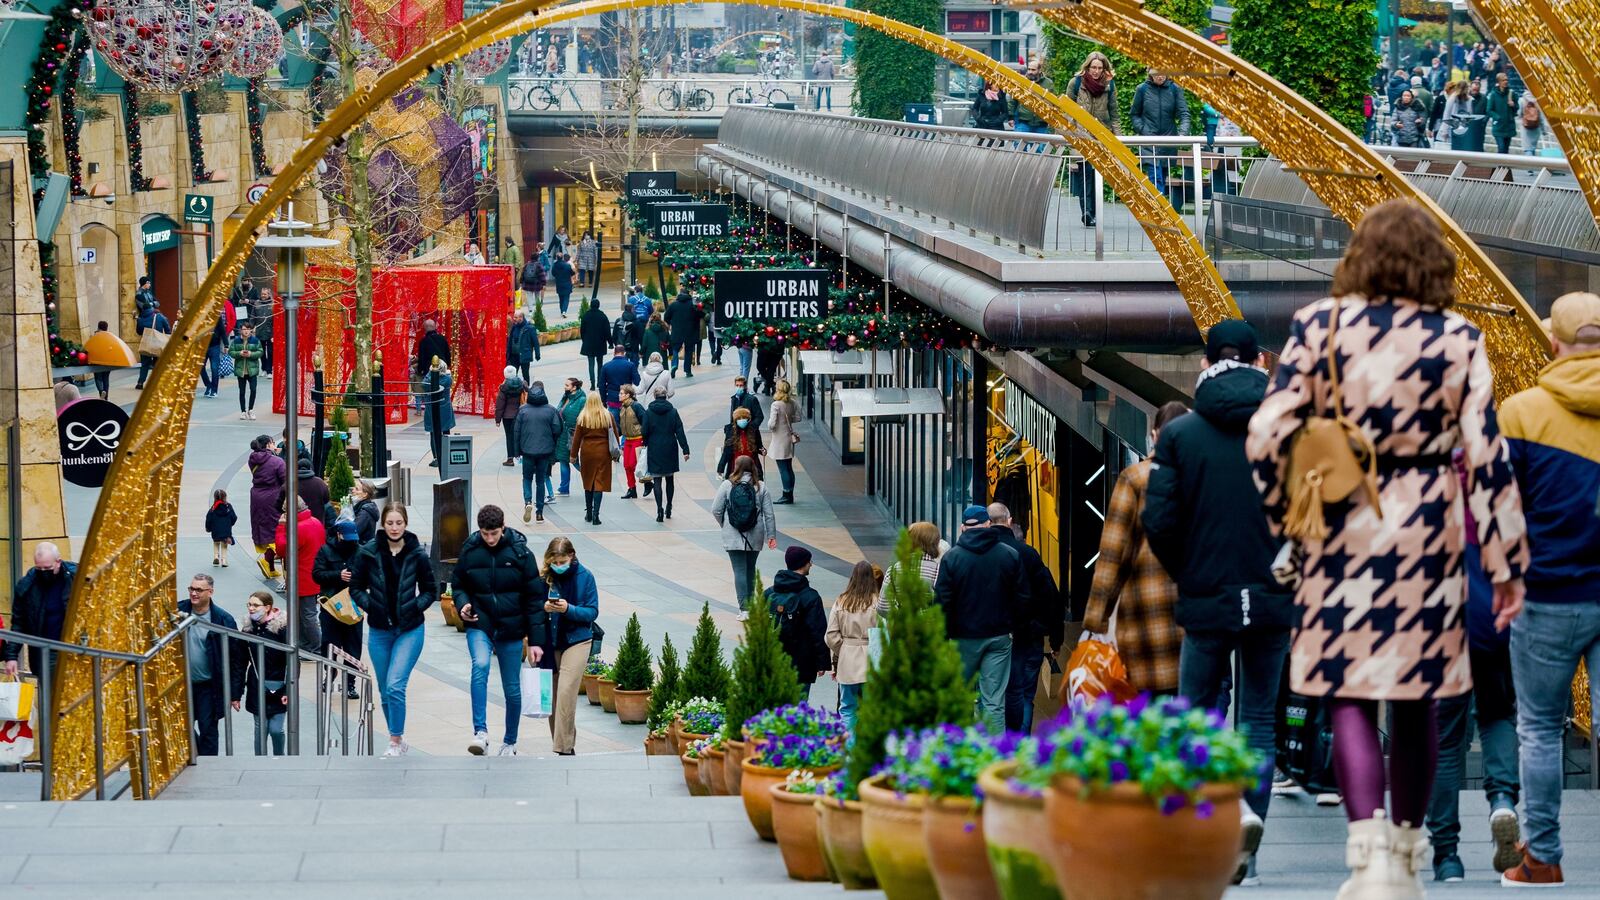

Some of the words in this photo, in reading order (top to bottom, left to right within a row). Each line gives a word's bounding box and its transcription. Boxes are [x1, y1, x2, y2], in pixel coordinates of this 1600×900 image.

[631, 188, 673, 196] SWAROVSKI
[660, 210, 695, 222] URBAN
[661, 224, 722, 236] OUTFITTERS
[145, 233, 153, 245] THE
[87, 251, 95, 262] P
[766, 279, 819, 297] URBAN
[724, 301, 819, 319] OUTFITTERS
[1022, 392, 1057, 466] OUTFITTERS
[60, 451, 118, 466] hunkemöl
